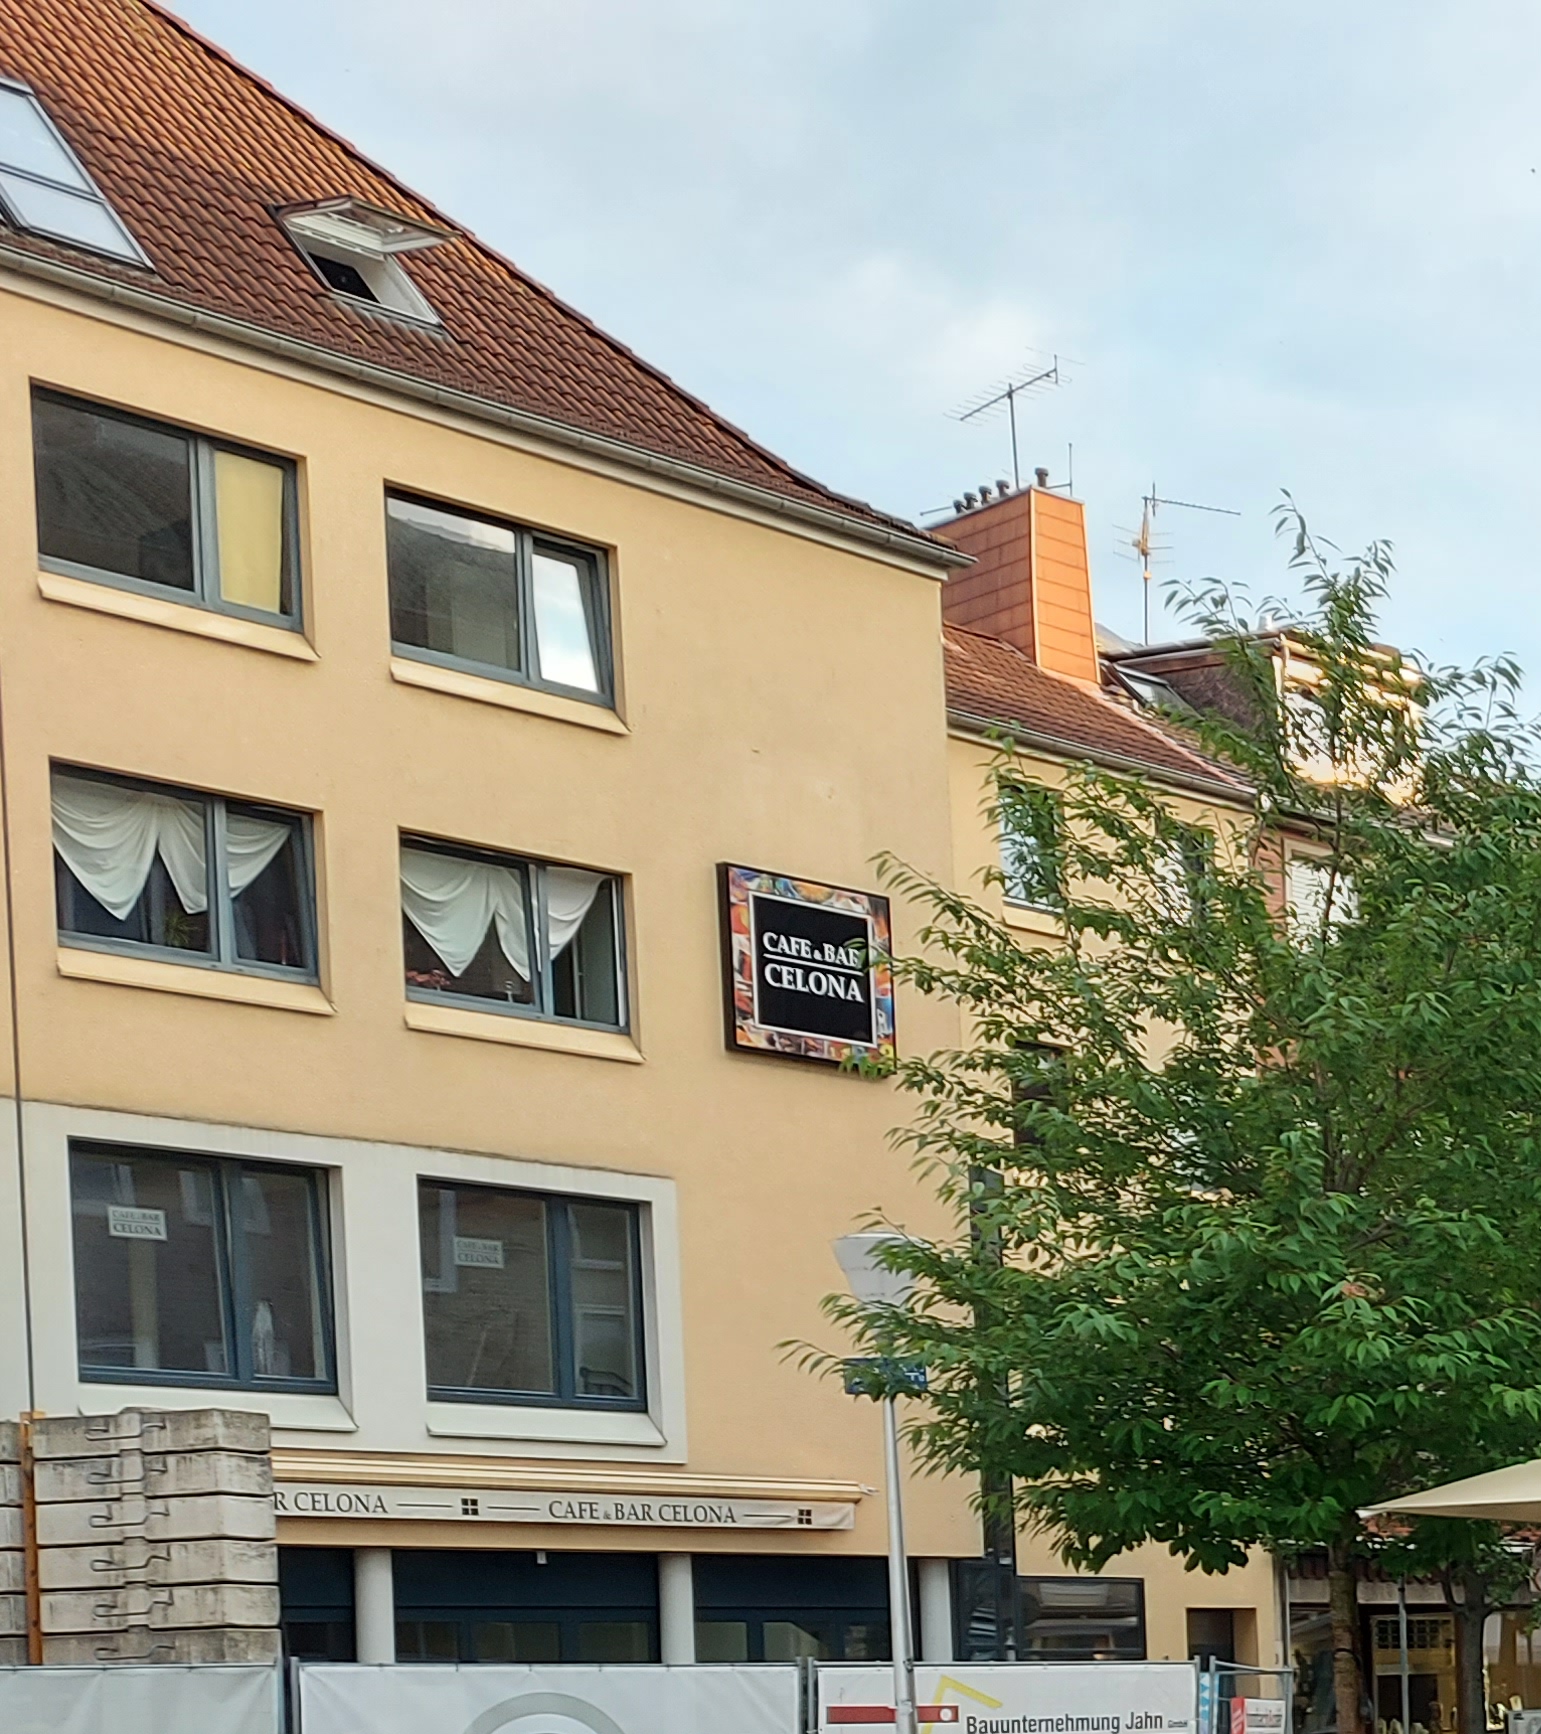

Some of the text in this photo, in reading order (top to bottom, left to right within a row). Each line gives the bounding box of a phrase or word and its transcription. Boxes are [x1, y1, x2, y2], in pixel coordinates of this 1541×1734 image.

[762, 931, 812, 959] CAFE
[764, 963, 865, 1003] CELONA
[294, 1491, 388, 1515] CELONA
[548, 1500, 599, 1520] CAFE
[613, 1502, 652, 1522] BAR
[657, 1503, 737, 1524] CELONA
[966, 1713, 1121, 1734] Bauunternehmung
[1125, 1711, 1163, 1731] Jahn
